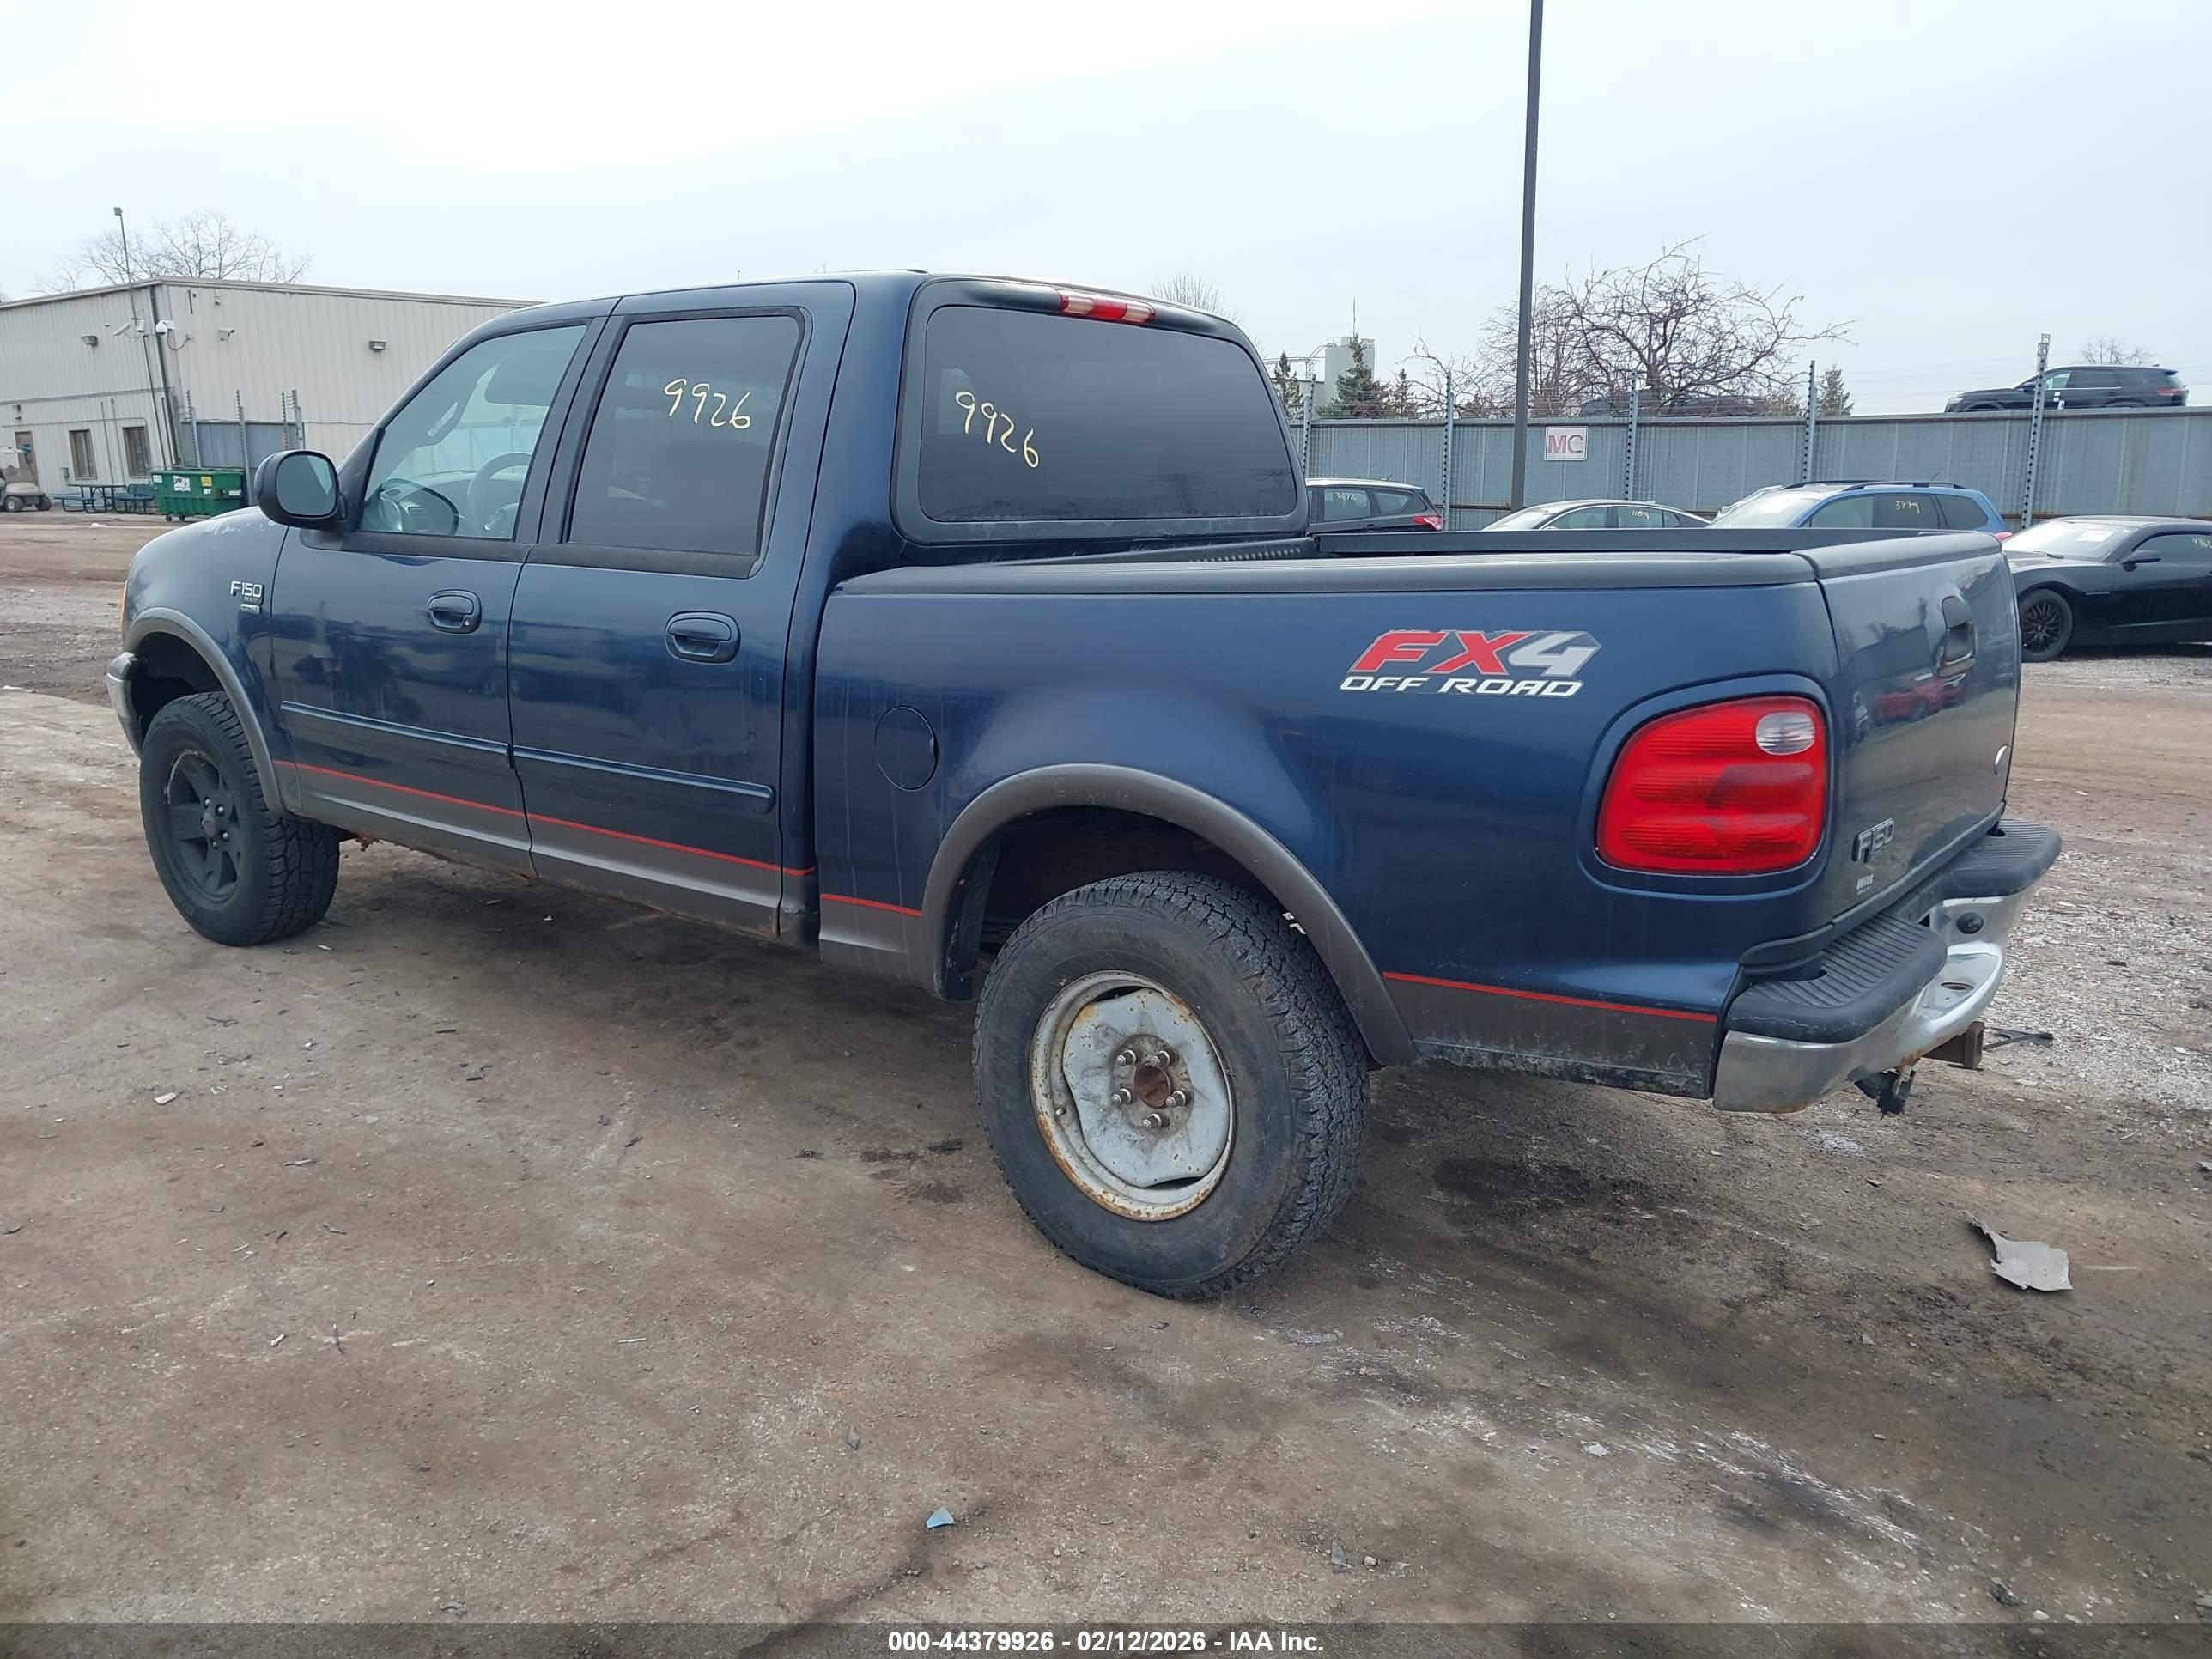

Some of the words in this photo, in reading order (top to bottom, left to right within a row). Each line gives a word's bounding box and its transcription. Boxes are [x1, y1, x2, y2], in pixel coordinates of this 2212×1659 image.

[664, 378, 750, 429] 9926
[955, 391, 1039, 468] 9926
[1547, 434, 1583, 454] MC
[230, 580, 263, 598] F150
[1348, 629, 1601, 676] FX4
[1340, 676, 1429, 691] OFF
[1440, 678, 1583, 697] ROAD
